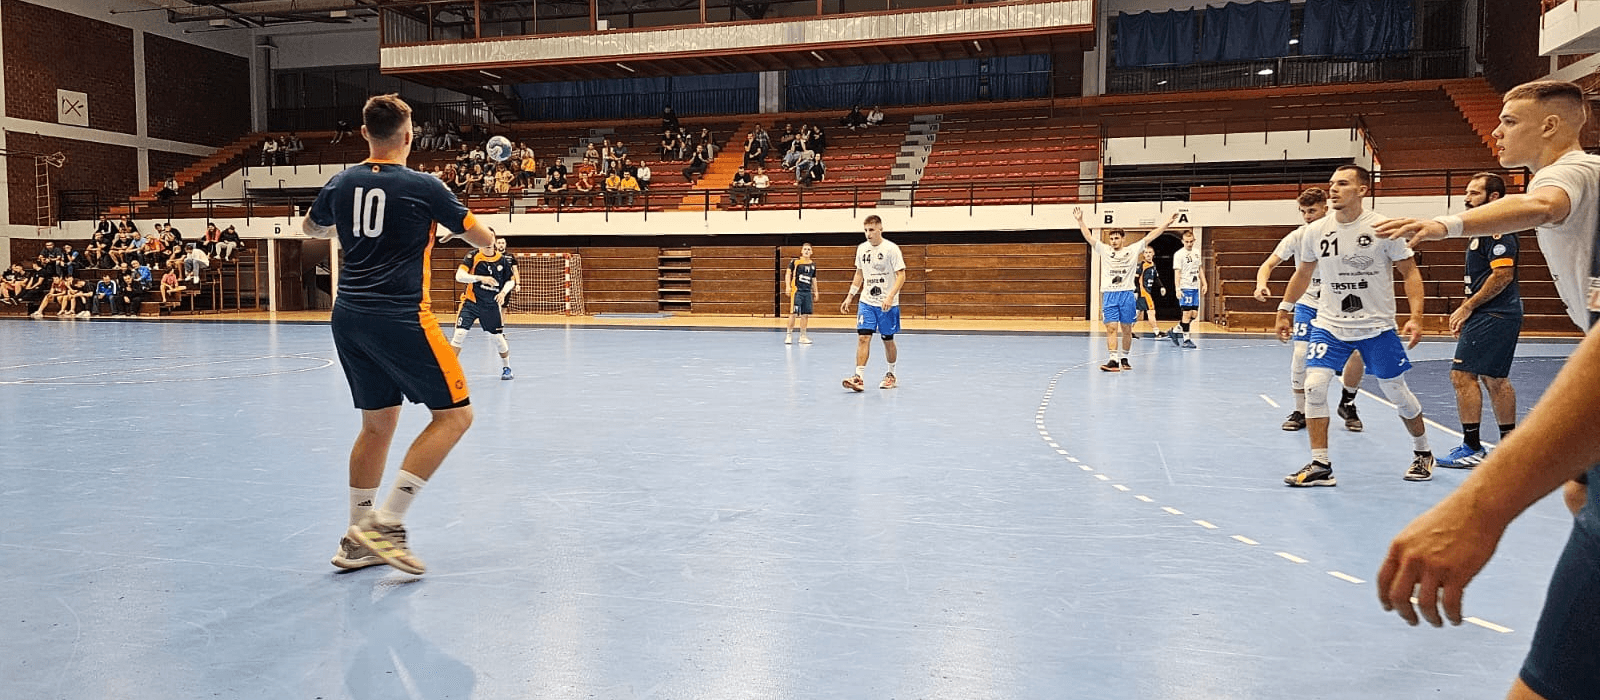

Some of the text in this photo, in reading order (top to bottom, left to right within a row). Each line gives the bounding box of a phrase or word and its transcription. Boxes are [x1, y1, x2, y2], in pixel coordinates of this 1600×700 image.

[352, 186, 387, 239] 10
[1178, 213, 1189, 223] A
[1104, 214, 1114, 224] B
[274, 226, 281, 235] D
[1320, 237, 1339, 258] 21
[862, 253, 872, 265] 44
[1330, 282, 1357, 290] ERSTE
[1307, 342, 1329, 360] 39
